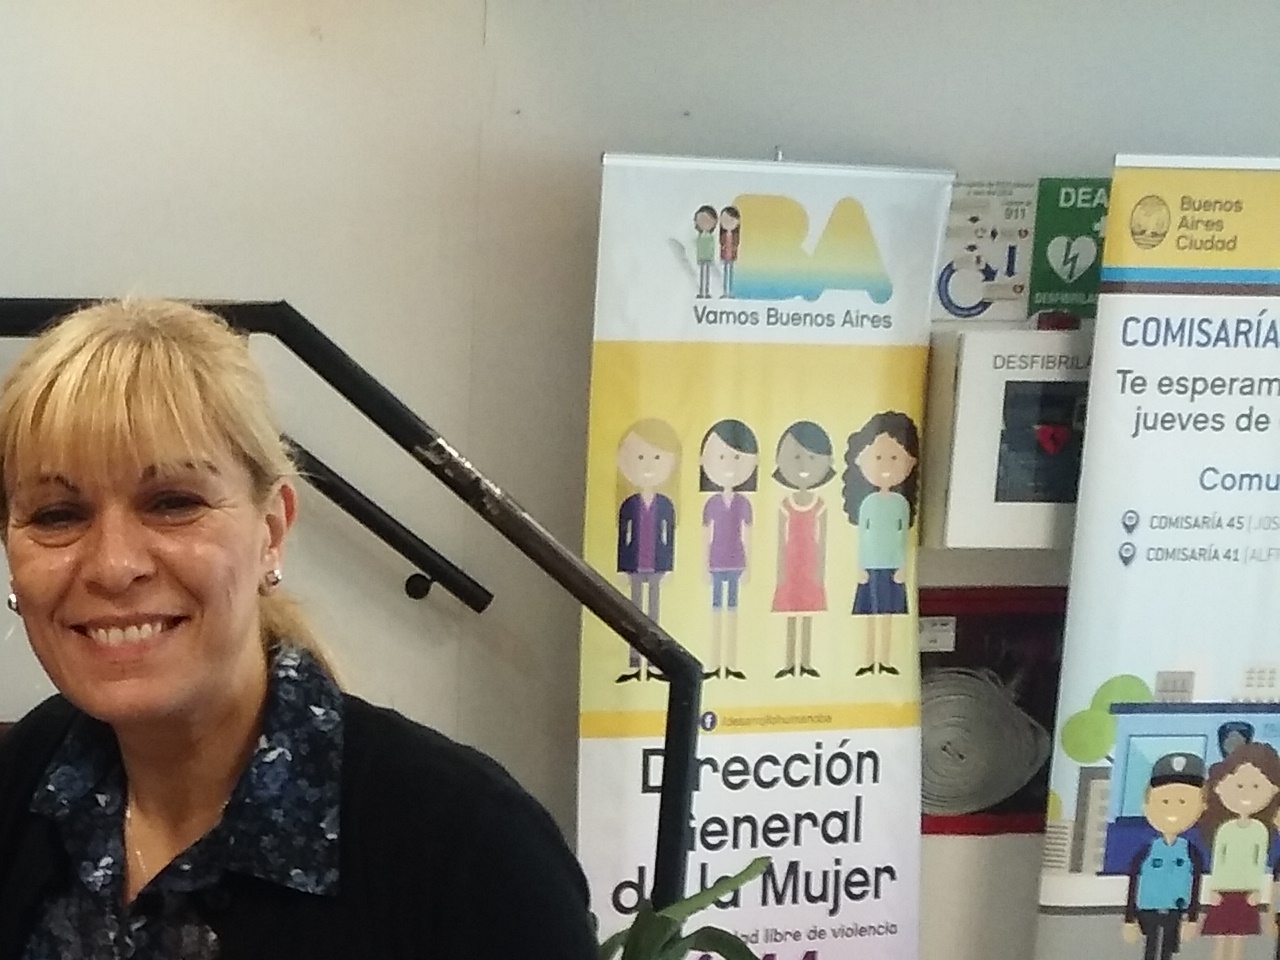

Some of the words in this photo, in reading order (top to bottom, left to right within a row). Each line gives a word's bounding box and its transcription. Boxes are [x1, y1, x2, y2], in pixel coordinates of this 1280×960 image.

[1058, 187, 1108, 208] DEA
[1180, 195, 1244, 213] Buenos
[1177, 214, 1224, 232] Aires
[1176, 234, 1239, 251] Ciudad
[693, 305, 759, 326] Vamos
[766, 308, 835, 328] Buenos
[841, 310, 893, 329] Aires
[1121, 308, 1280, 349] COMISARÍA
[1116, 369, 1148, 395] Te
[1131, 405, 1226, 438] jueves
[1235, 405, 1272, 432] de
[1149, 512, 1224, 530] COMISARÍA
[1226, 515, 1245, 530] 45
[1146, 544, 1220, 562] COMISARÍA
[1222, 547, 1240, 562] 41
[642, 738, 880, 794] Drección
[686, 795, 863, 852] eneral
[761, 856, 898, 917] Mujer
[764, 926, 802, 943] libre
[807, 925, 827, 940] de
[831, 921, 899, 939] violencia
